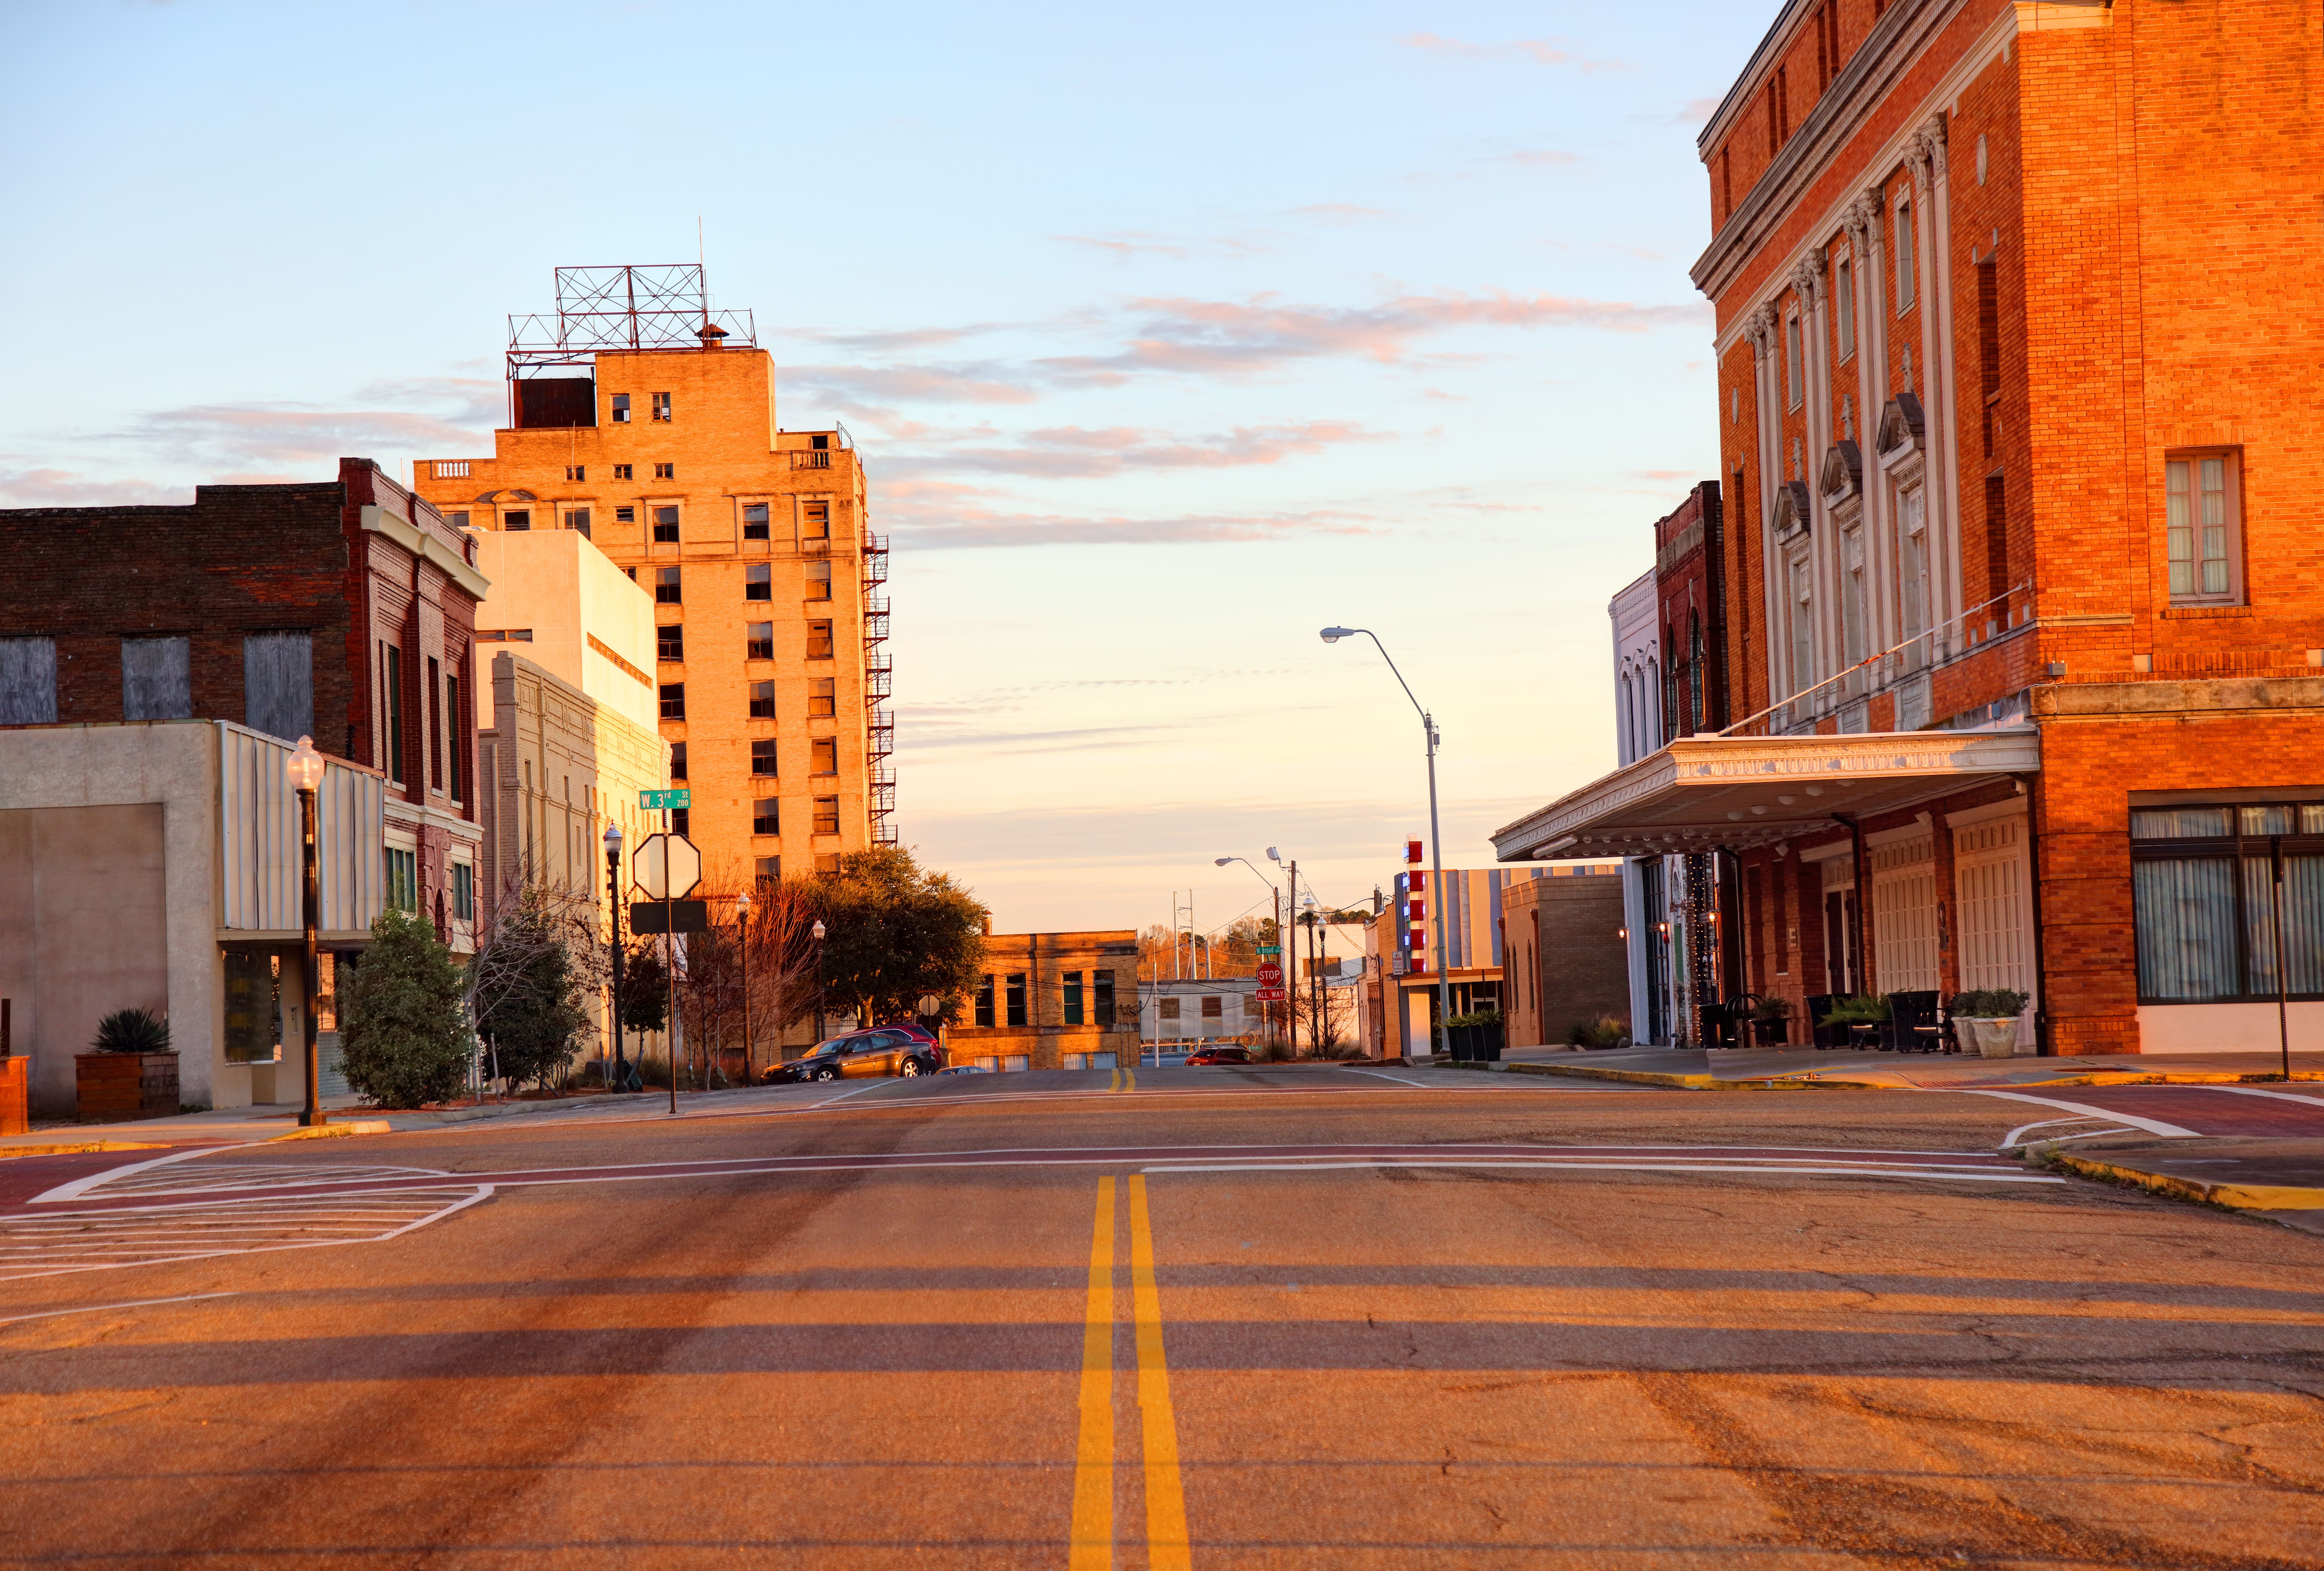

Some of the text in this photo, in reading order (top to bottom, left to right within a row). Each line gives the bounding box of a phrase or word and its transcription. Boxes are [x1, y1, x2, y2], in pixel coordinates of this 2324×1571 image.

[641, 794, 654, 808] W.
[657, 792, 671, 807] 3rd
[1259, 970, 1280, 980] STOP
